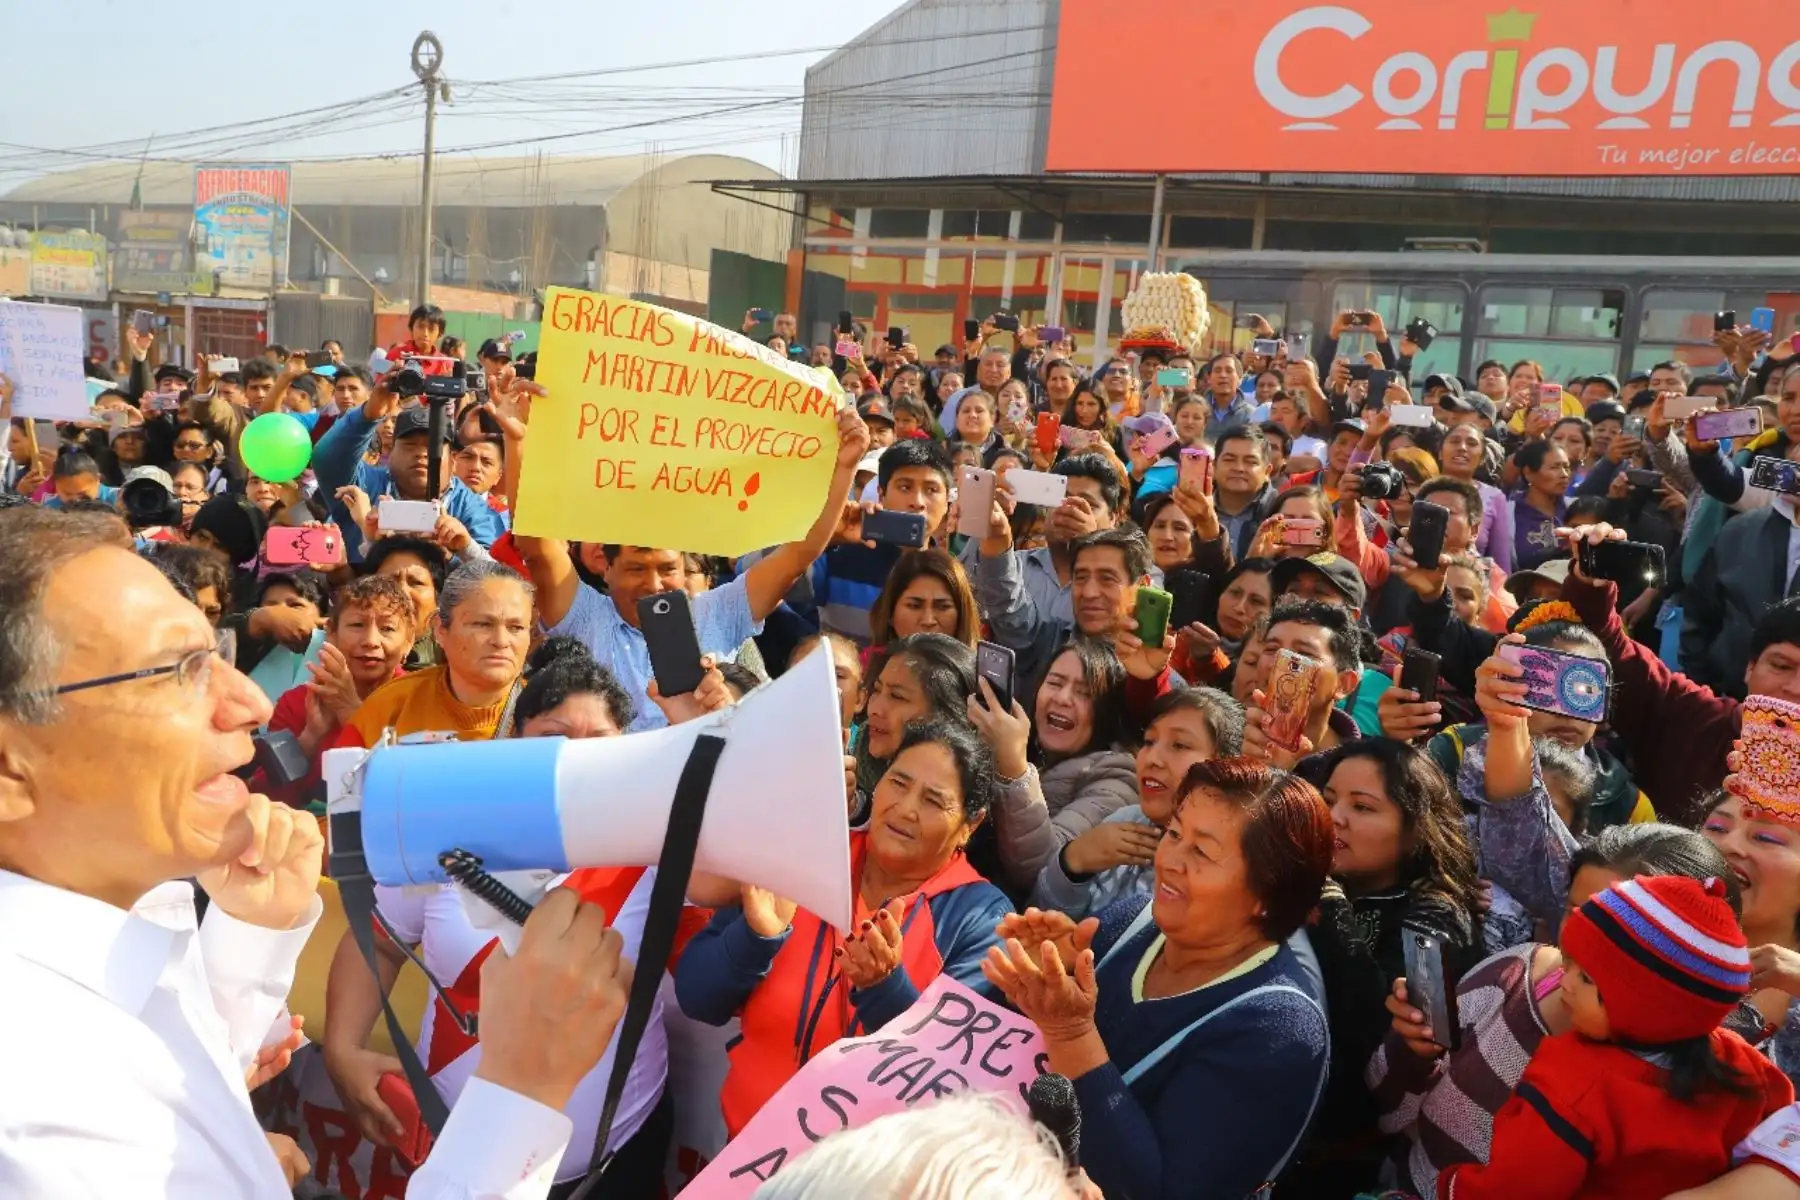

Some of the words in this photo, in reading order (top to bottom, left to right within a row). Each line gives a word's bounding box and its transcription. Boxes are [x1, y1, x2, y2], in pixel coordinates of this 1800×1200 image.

[1597, 145, 1627, 164] Tu
[1639, 142, 1720, 171] mejor
[1728, 141, 1800, 164] elecc
[552, 293, 675, 347] GRACIAS
[582, 348, 700, 397] MARTIN
[705, 367, 840, 419] VIZCARRA
[577, 402, 639, 444] POR
[650, 414, 687, 448] EL
[695, 416, 823, 459] PROYECTO
[595, 458, 637, 489] DE
